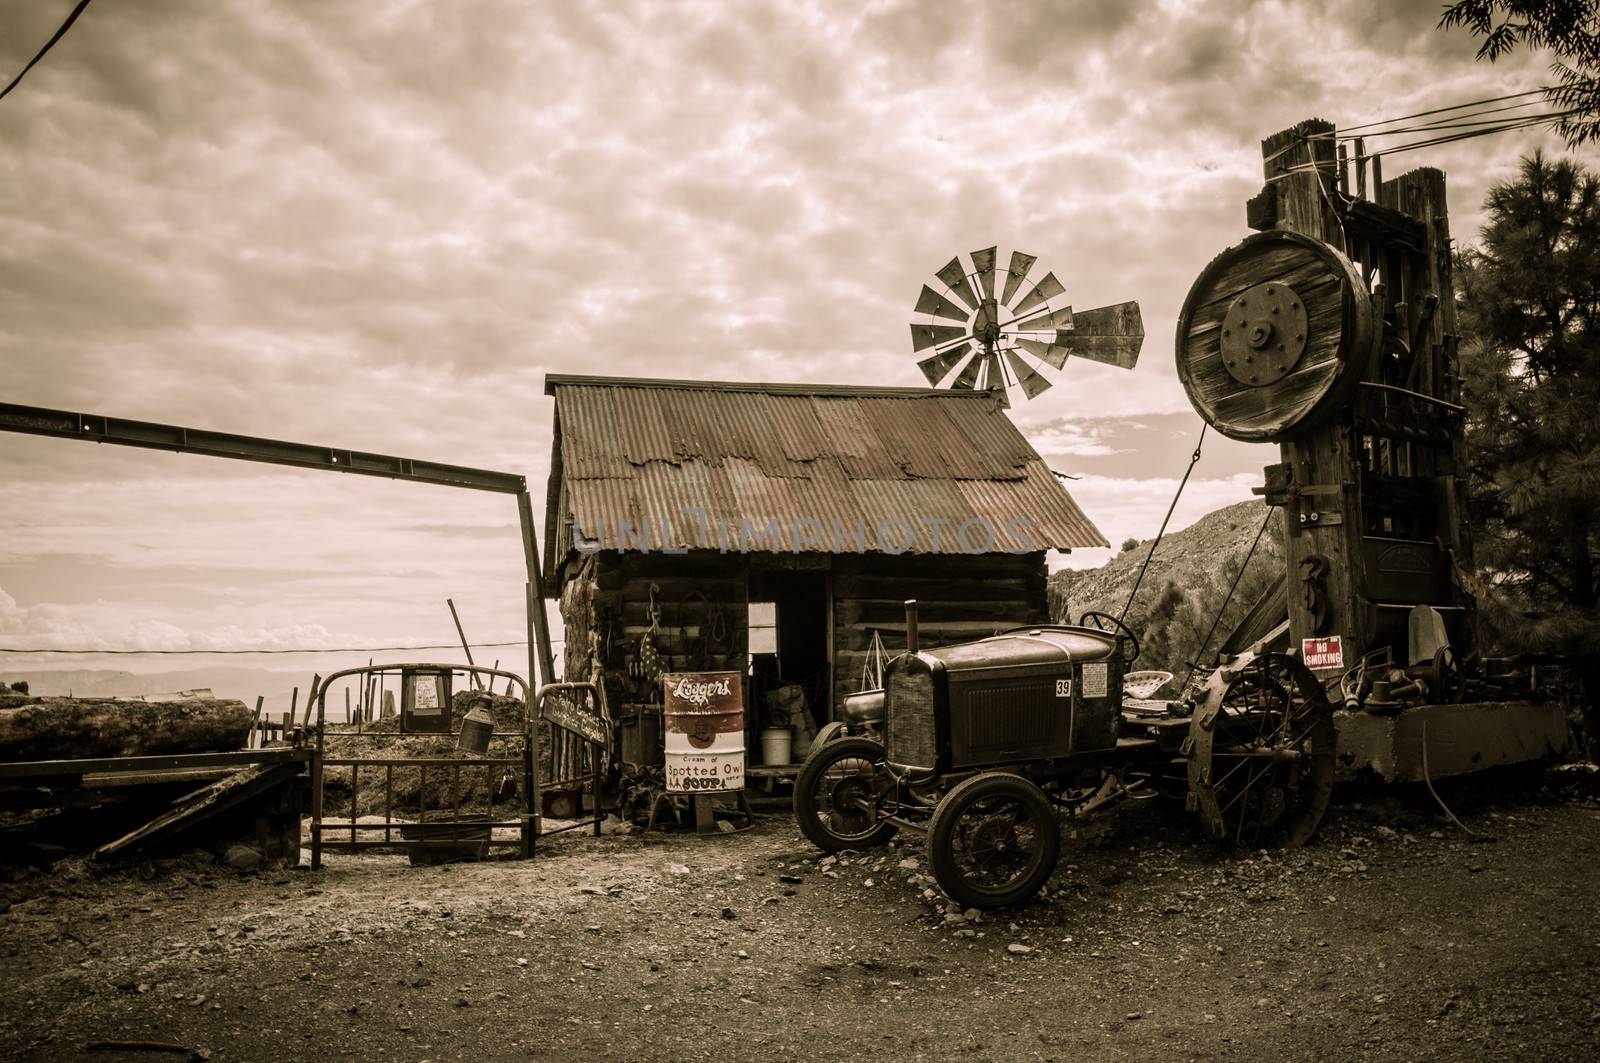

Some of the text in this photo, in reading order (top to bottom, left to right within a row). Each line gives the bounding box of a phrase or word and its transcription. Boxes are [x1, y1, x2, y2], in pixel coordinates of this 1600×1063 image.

[1316, 642, 1327, 653] NO
[1306, 652, 1341, 666] SMOKING
[673, 678, 732, 705] Loggers
[1057, 681, 1070, 695] 39
[668, 764, 717, 776] Spotted
[683, 776, 720, 790] SOUP
